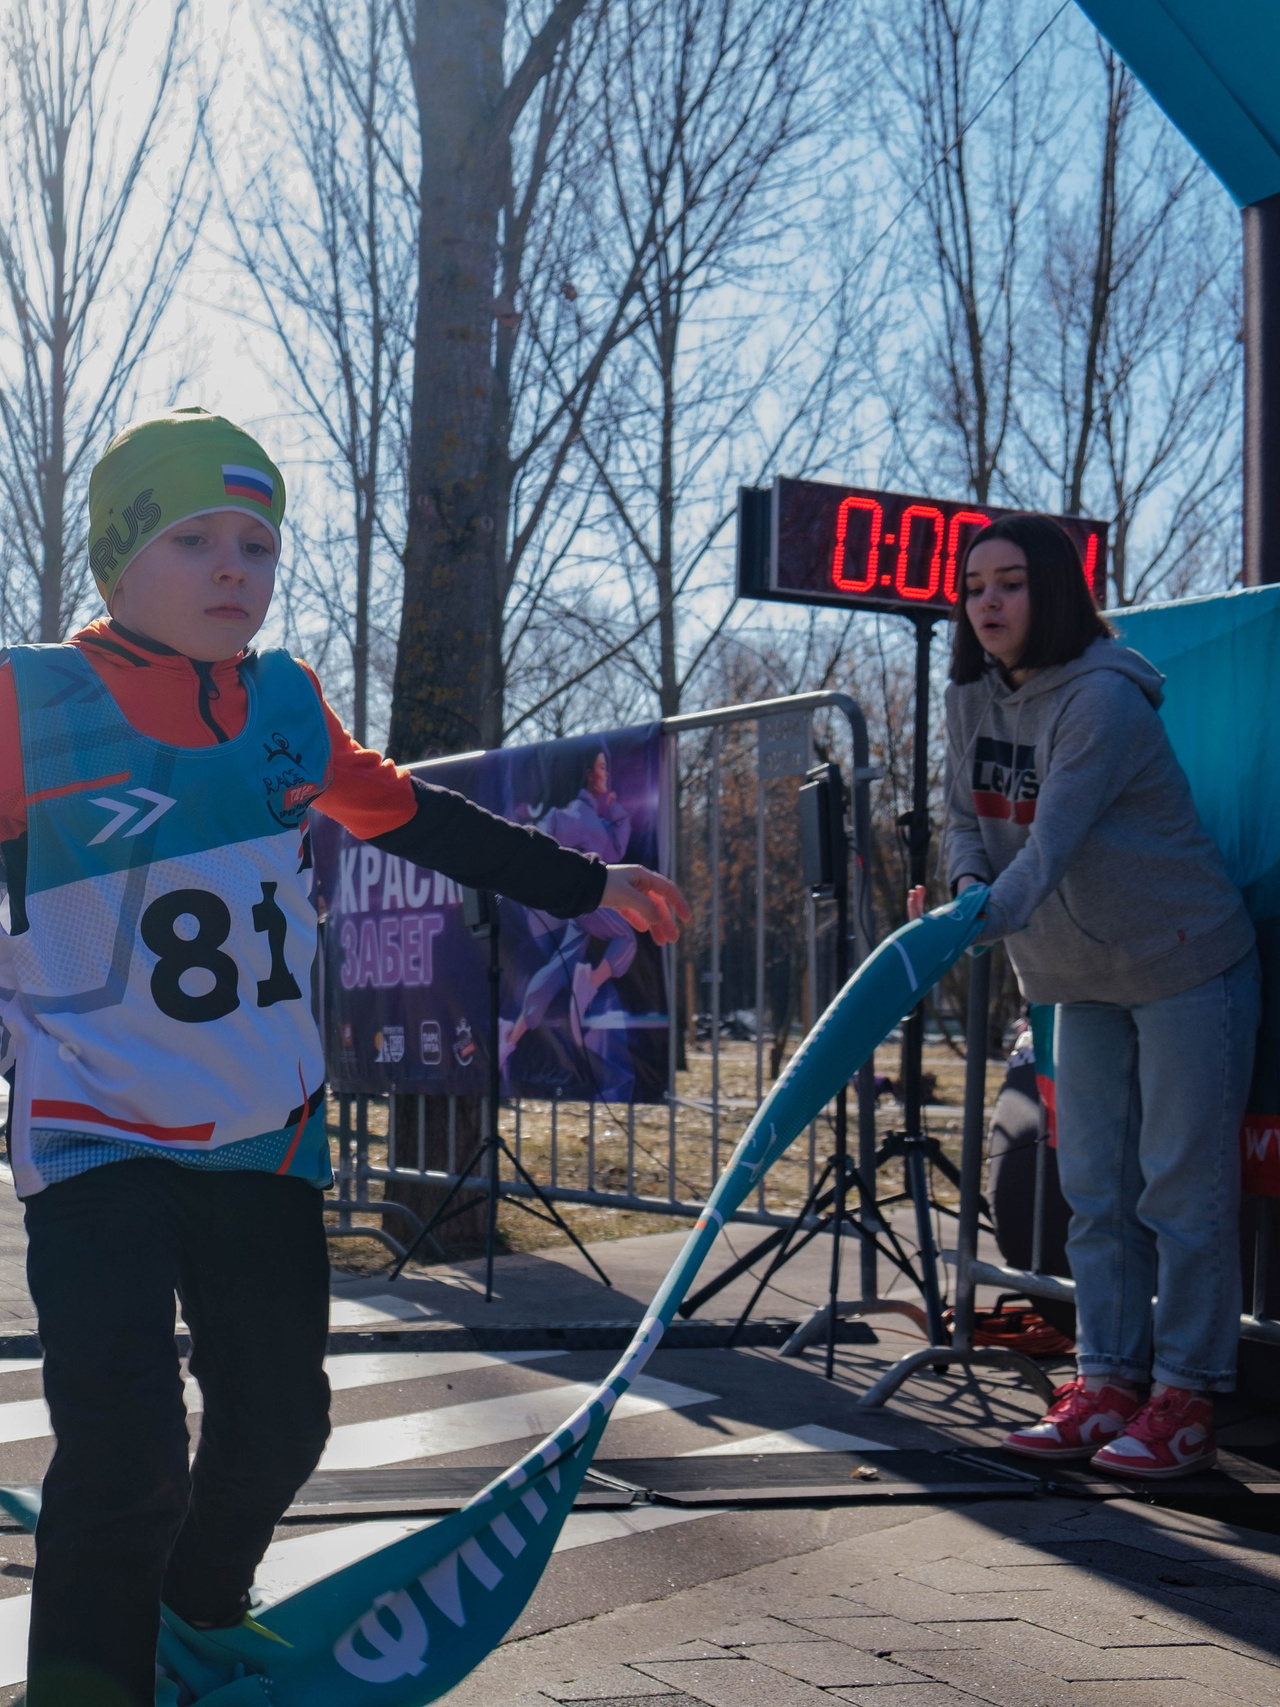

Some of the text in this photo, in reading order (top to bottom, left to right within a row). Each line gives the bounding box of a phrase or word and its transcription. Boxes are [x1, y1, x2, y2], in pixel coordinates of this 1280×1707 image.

[90, 488, 162, 584] RUS
[340, 844, 464, 915] КРАСИ
[141, 881, 302, 1024] 81
[341, 912, 445, 989] ЗАБЕГ
